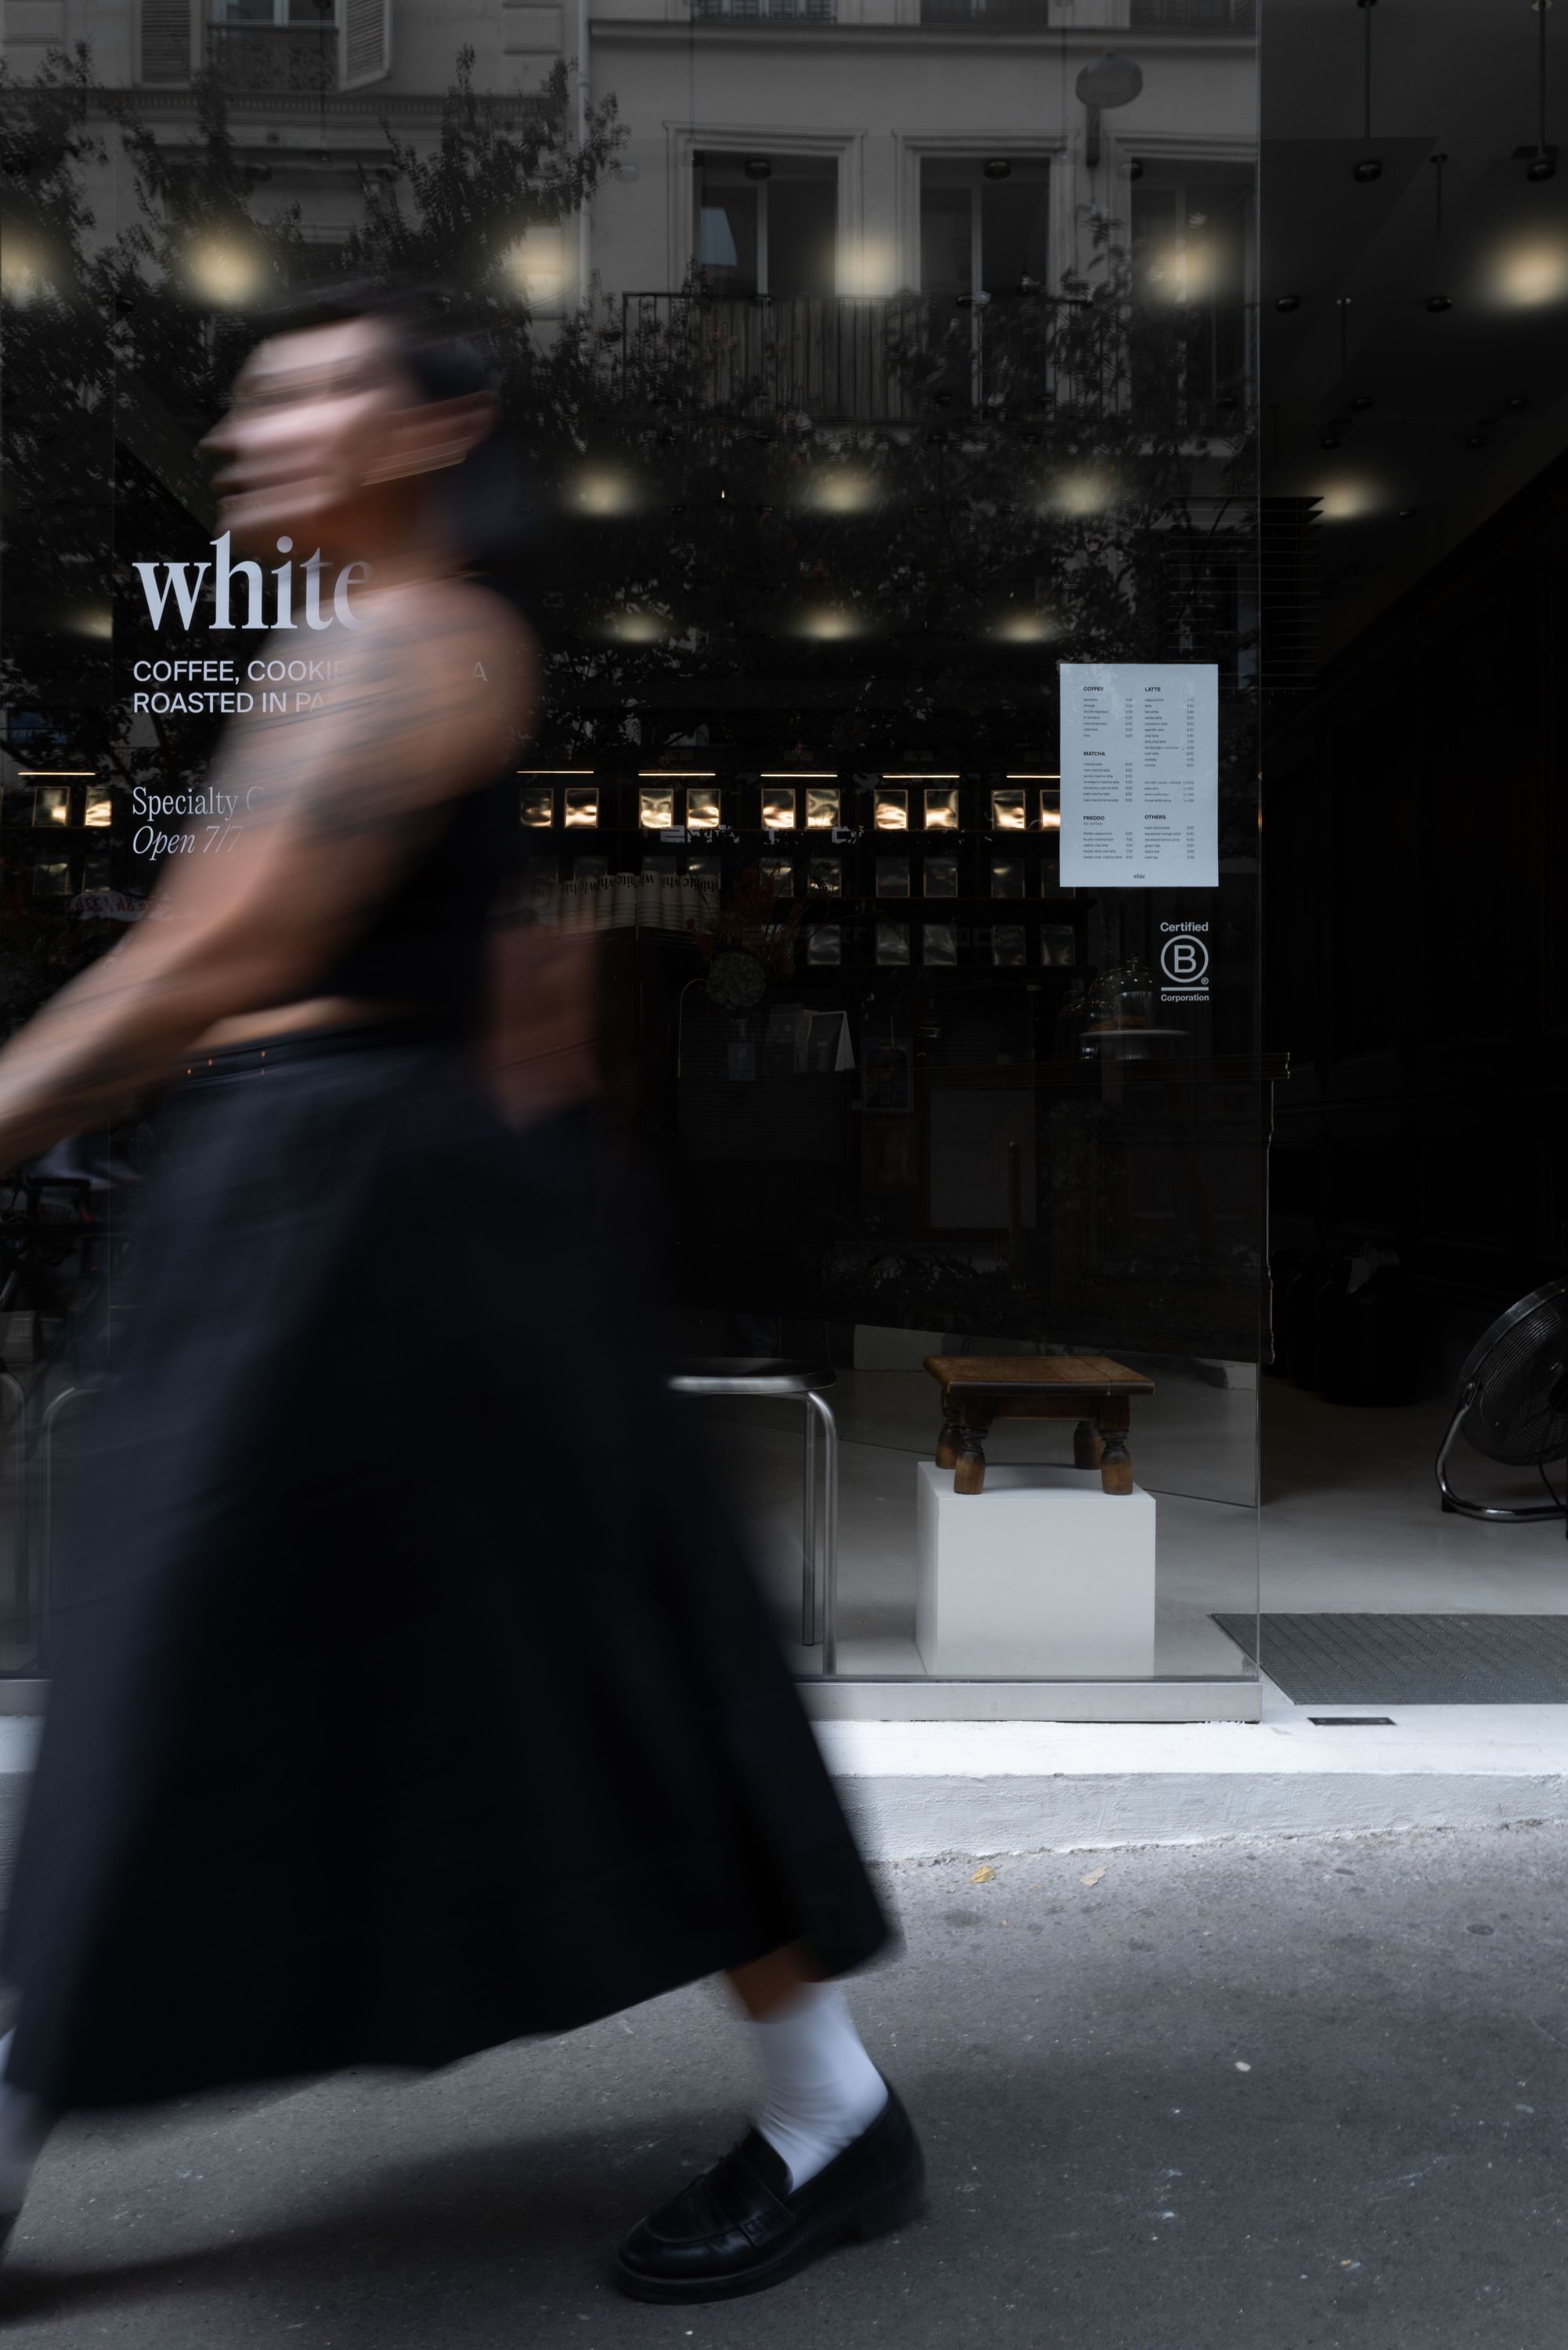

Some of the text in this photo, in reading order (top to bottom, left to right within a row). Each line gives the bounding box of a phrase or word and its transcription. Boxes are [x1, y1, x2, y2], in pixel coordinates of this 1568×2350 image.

[133, 660, 240, 685] COFFEE,
[133, 692, 254, 714] ROASTED
[263, 692, 287, 714] IN
[132, 786, 239, 822] Specialty
[132, 825, 245, 861] Open 7/7
[1160, 922, 1209, 932] Certified
[1174, 944, 1197, 973] B
[1161, 994, 1209, 1003] Corporation
